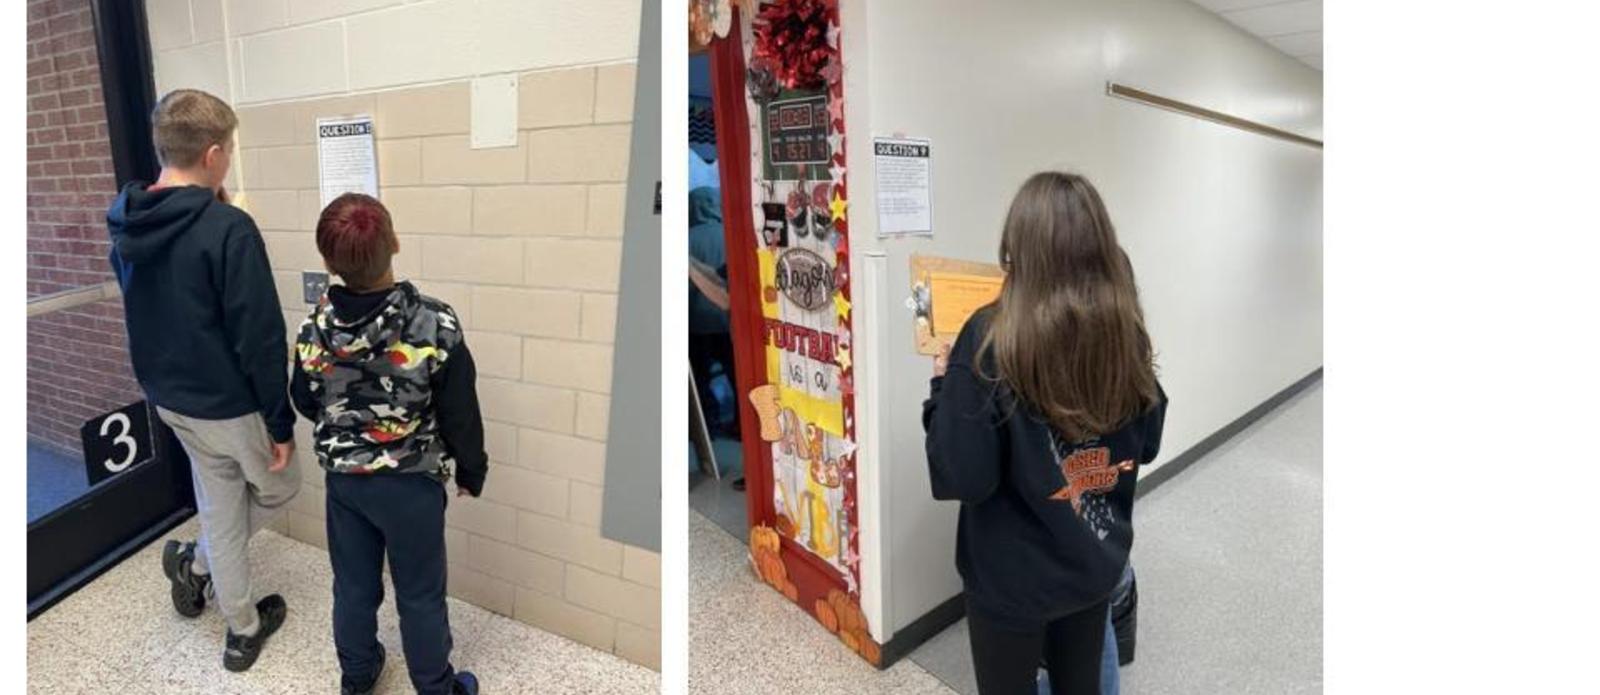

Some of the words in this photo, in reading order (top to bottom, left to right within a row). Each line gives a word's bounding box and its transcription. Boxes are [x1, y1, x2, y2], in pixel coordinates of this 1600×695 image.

[321, 124, 365, 137] QUESTION
[877, 143, 919, 156] QUESTION
[762, 318, 843, 367] FOOTBA
[100, 412, 138, 473] 3
